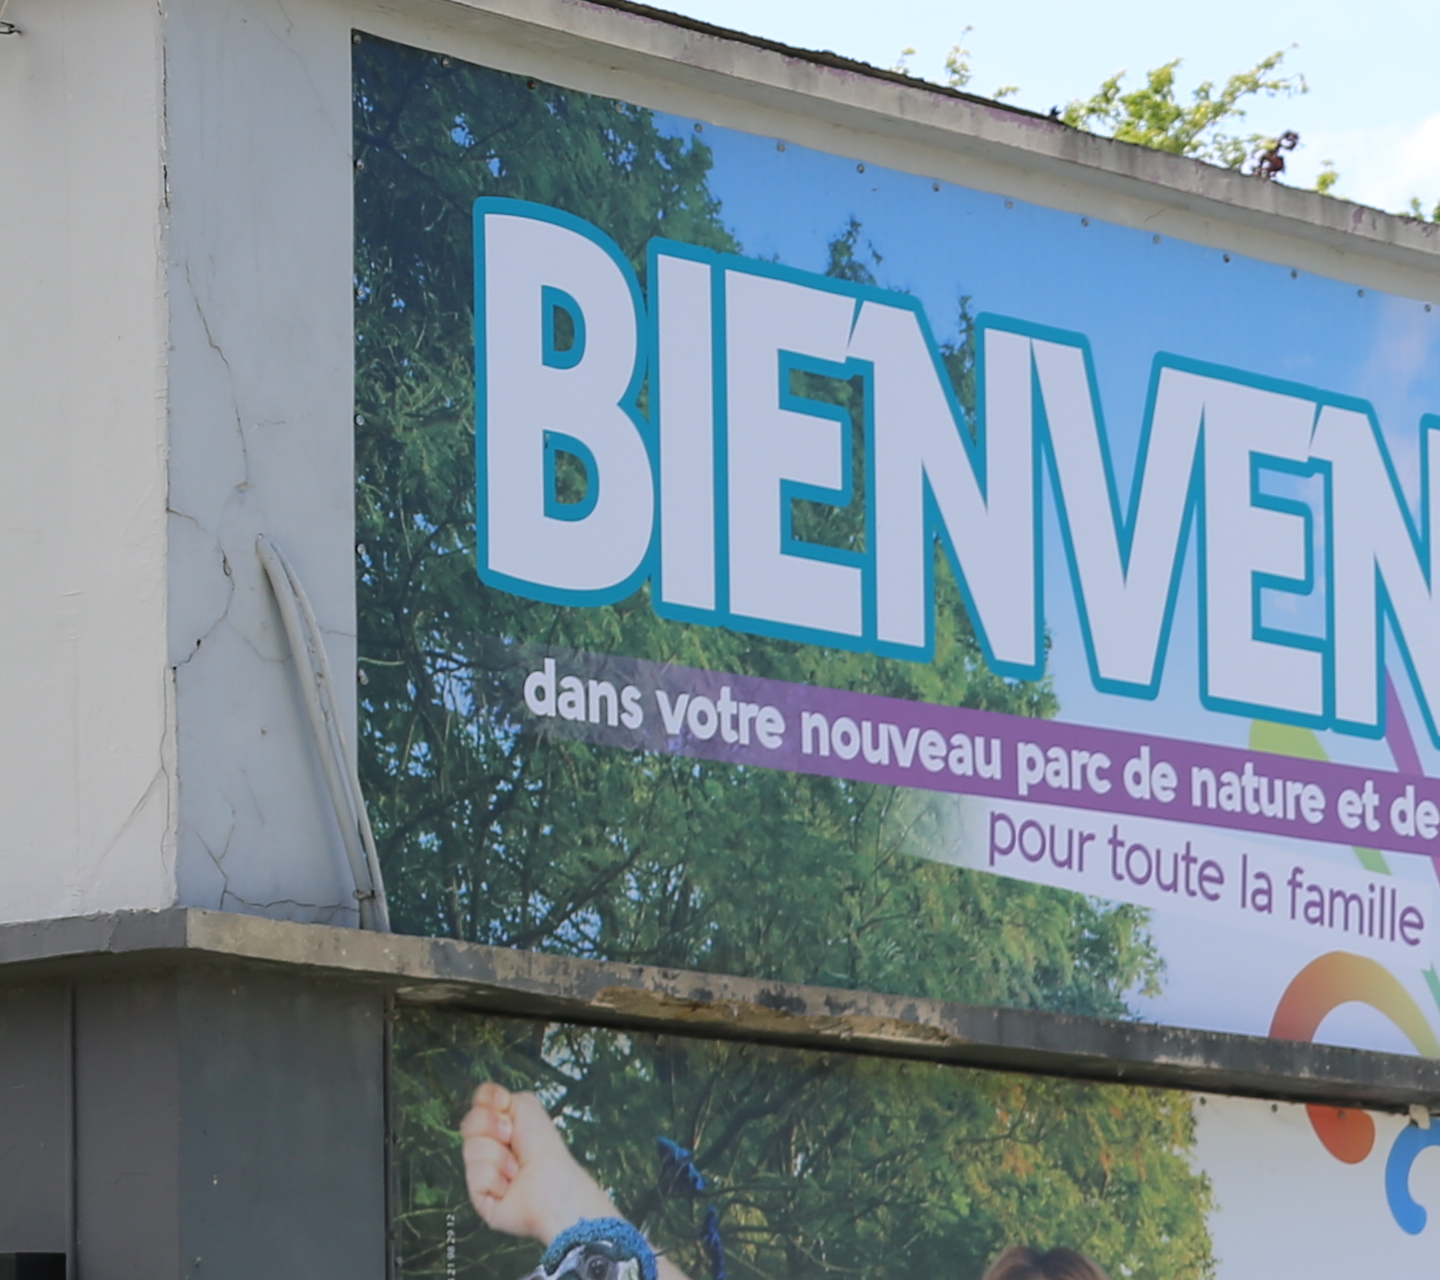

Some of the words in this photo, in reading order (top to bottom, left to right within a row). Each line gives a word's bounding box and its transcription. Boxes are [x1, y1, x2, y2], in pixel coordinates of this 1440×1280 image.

[523, 657, 643, 730] dans
[656, 686, 785, 749] votre
[802, 710, 1002, 780] nouveau
[1016, 740, 1112, 795] parc
[1123, 745, 1178, 802] de
[1192, 761, 1326, 824] nature
[1337, 779, 1381, 832] et
[1390, 785, 1440, 839] de
[987, 810, 1095, 873] pour
[1107, 824, 1226, 901] toute
[1239, 853, 1273, 914] la
[1286, 868, 1426, 945] famille
